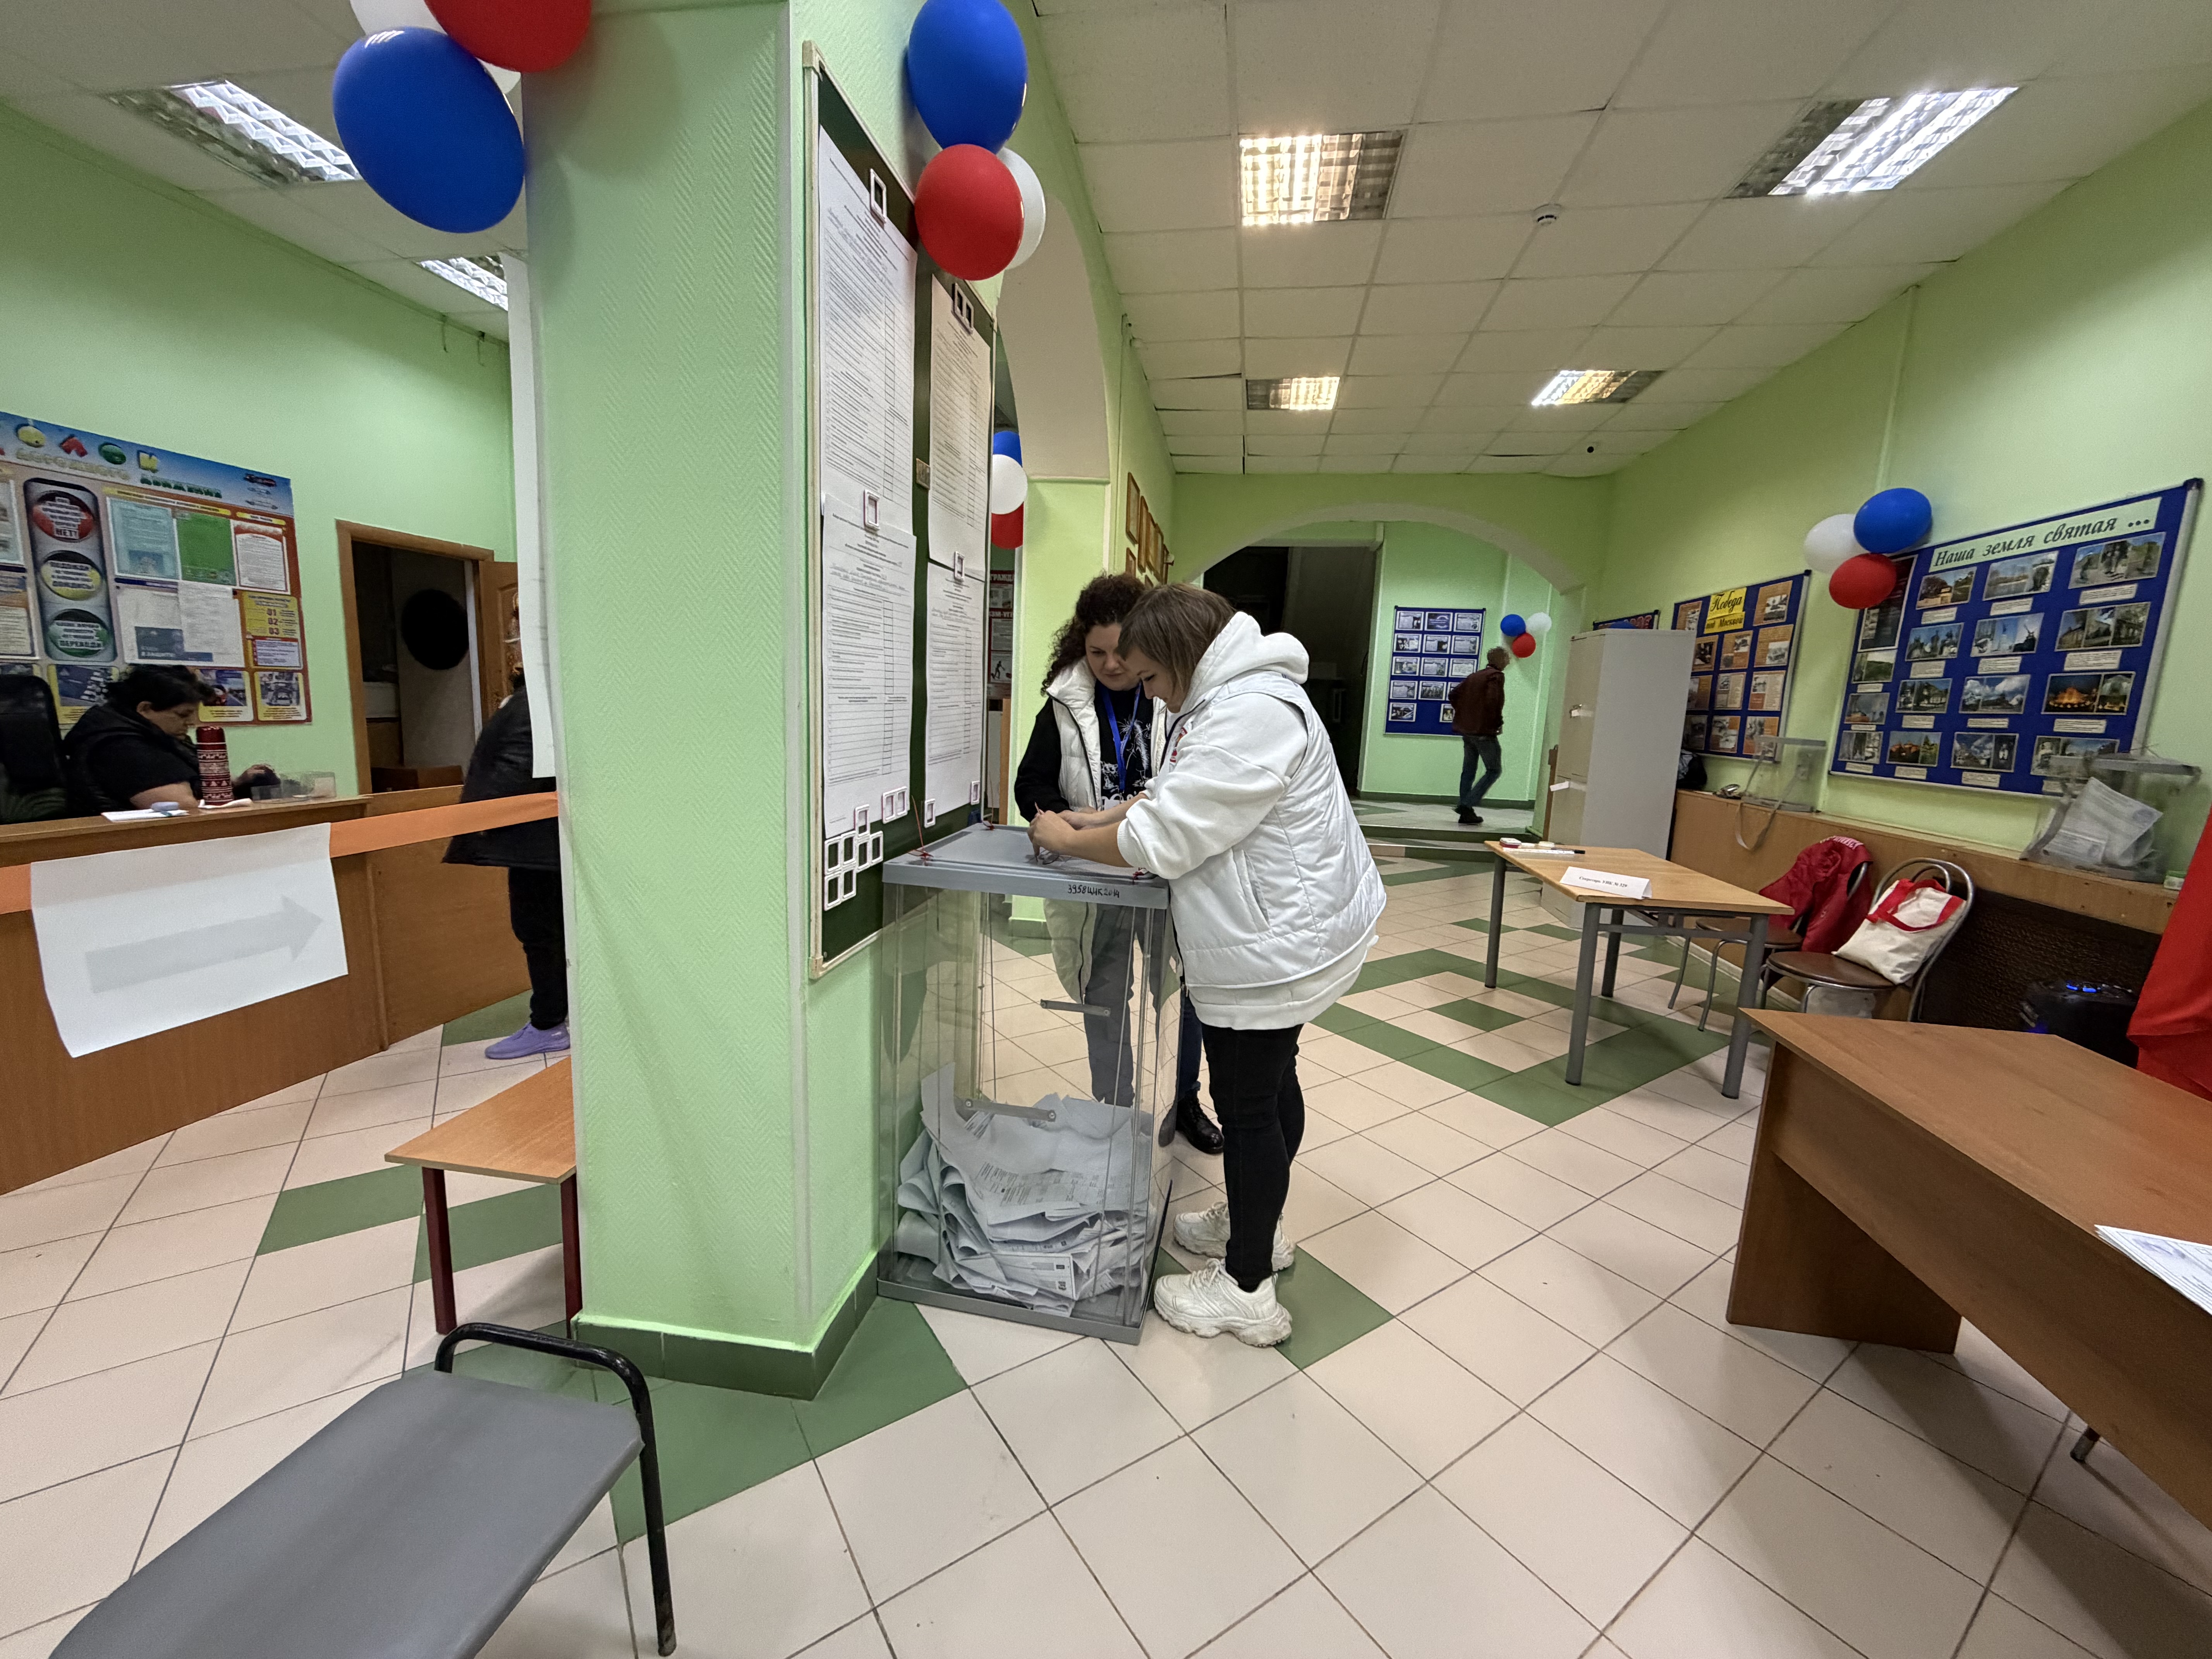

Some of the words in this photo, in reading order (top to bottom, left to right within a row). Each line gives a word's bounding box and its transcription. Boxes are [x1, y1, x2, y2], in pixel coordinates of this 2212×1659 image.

[56, 528, 77, 537] НЕТ!
[1933, 547, 1977, 567] Наша
[1982, 535, 2035, 556] земля
[2044, 517, 2118, 544] святая
[1710, 591, 1743, 613] Победа
